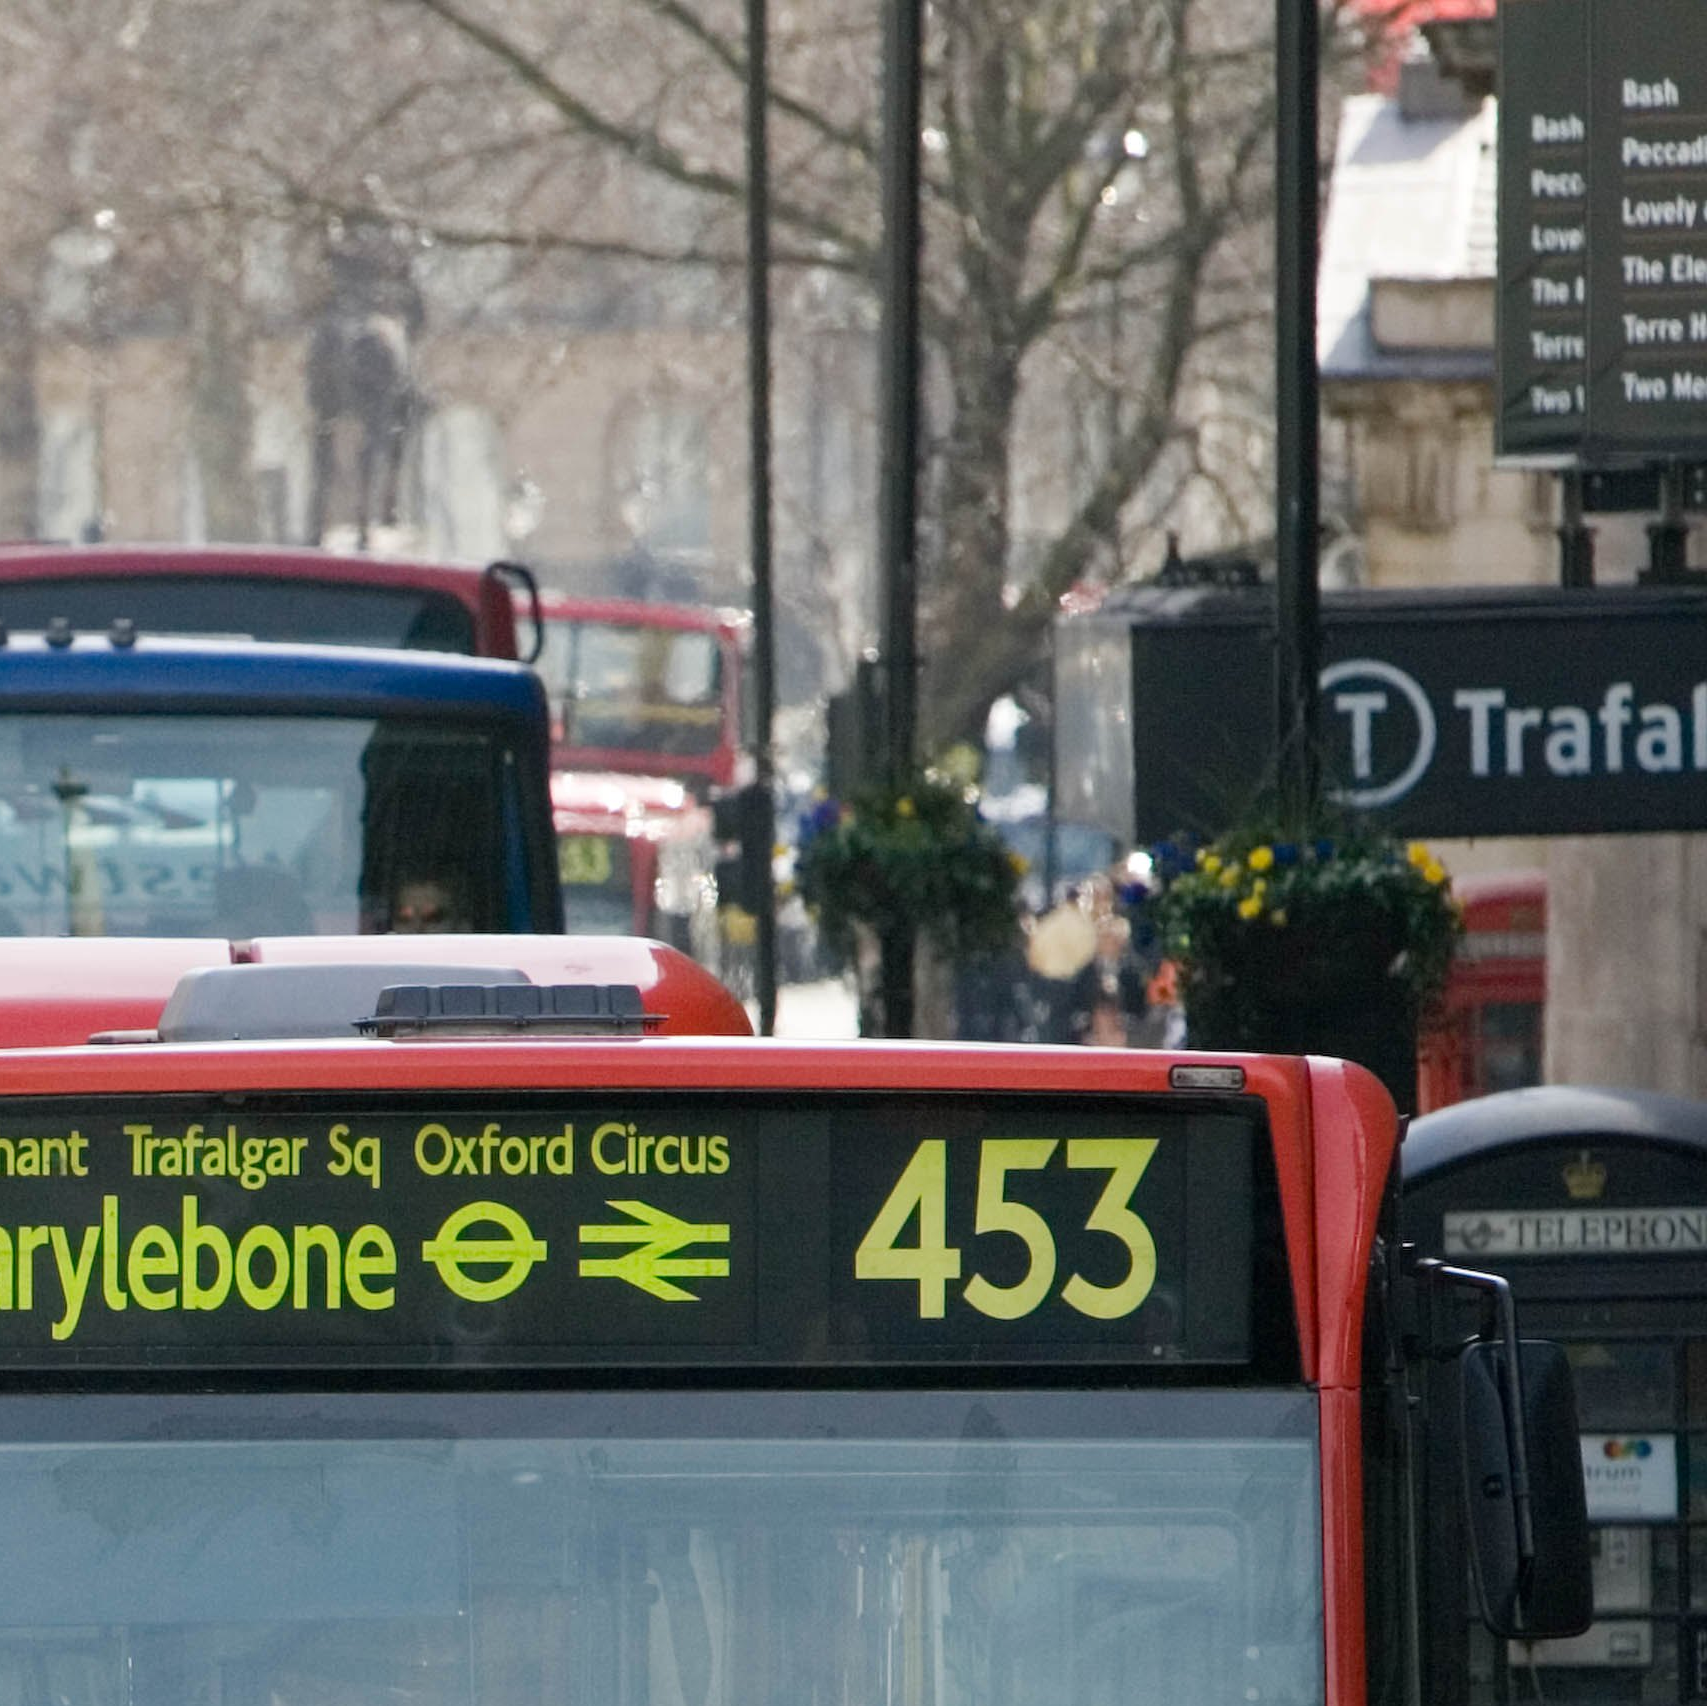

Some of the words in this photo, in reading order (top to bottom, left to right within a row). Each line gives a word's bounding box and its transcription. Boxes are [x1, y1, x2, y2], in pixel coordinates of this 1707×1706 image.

[1621, 77, 1680, 107] Bash
[1531, 113, 1585, 143] Bash
[1621, 195, 1698, 228] Lovely
[1622, 255, 1665, 284] The
[1530, 276, 1570, 306] The
[1621, 313, 1684, 344] Terre
[1530, 385, 1572, 414] Two
[1620, 372, 1667, 402] Two
[123, 1124, 309, 1190] Trafalgar
[327, 1124, 381, 1188] Sq
[413, 1123, 574, 1176] Oxford
[590, 1122, 730, 1176] Circus
[854, 1138, 1160, 1320] 453
[1509, 1213, 1704, 1250] TELEPHON
